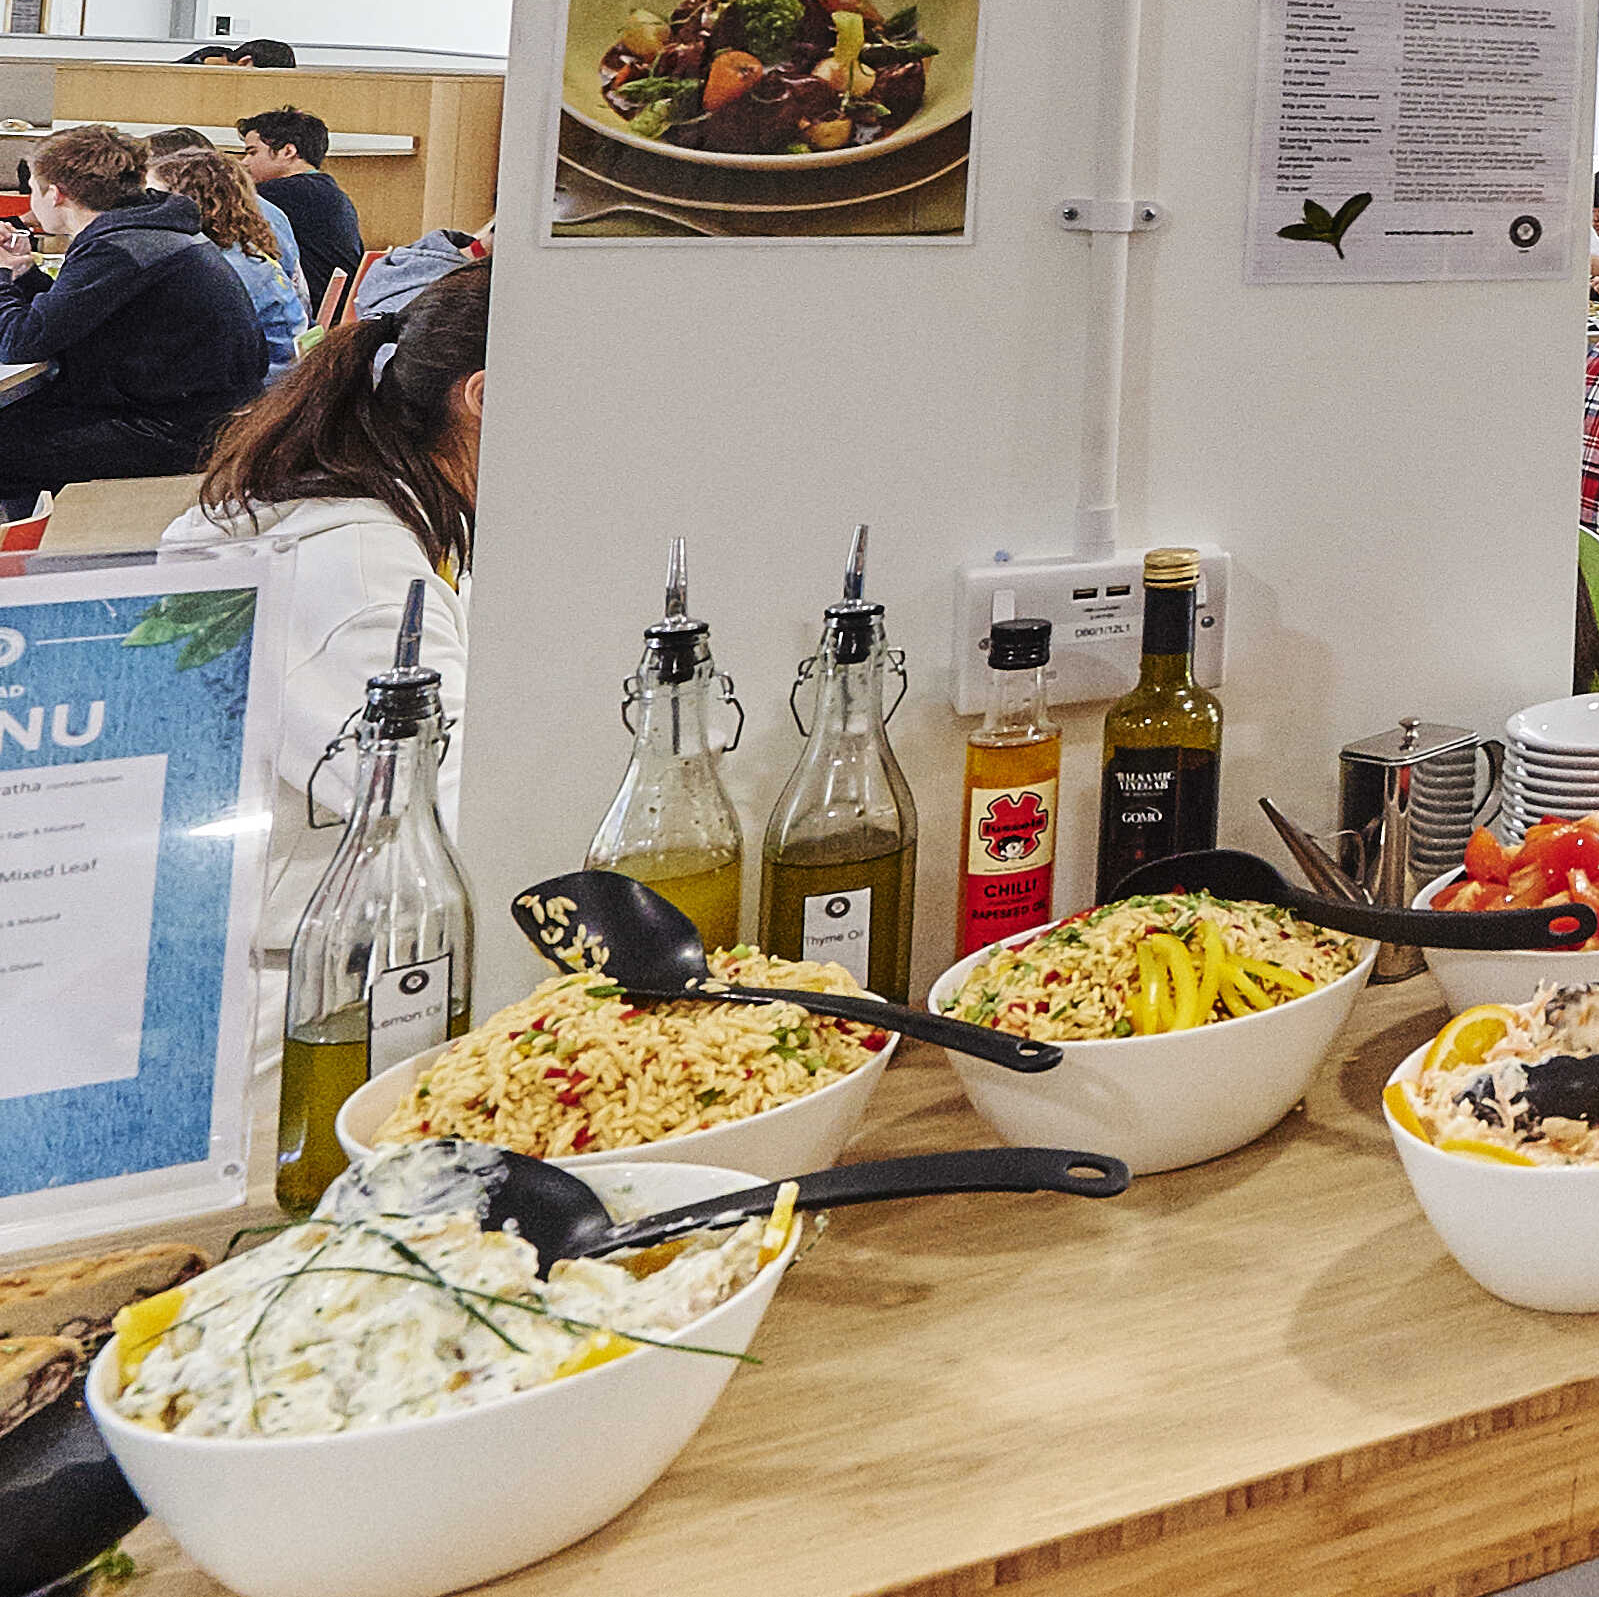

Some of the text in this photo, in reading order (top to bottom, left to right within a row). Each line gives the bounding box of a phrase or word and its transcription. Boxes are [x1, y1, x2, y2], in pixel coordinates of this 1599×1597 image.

[0, 857, 98, 883] Mixed Leaf
[983, 878, 1038, 898] CHILLI
[971, 903, 1030, 920] RAPESEED
[805, 932, 845, 948] Thyme
